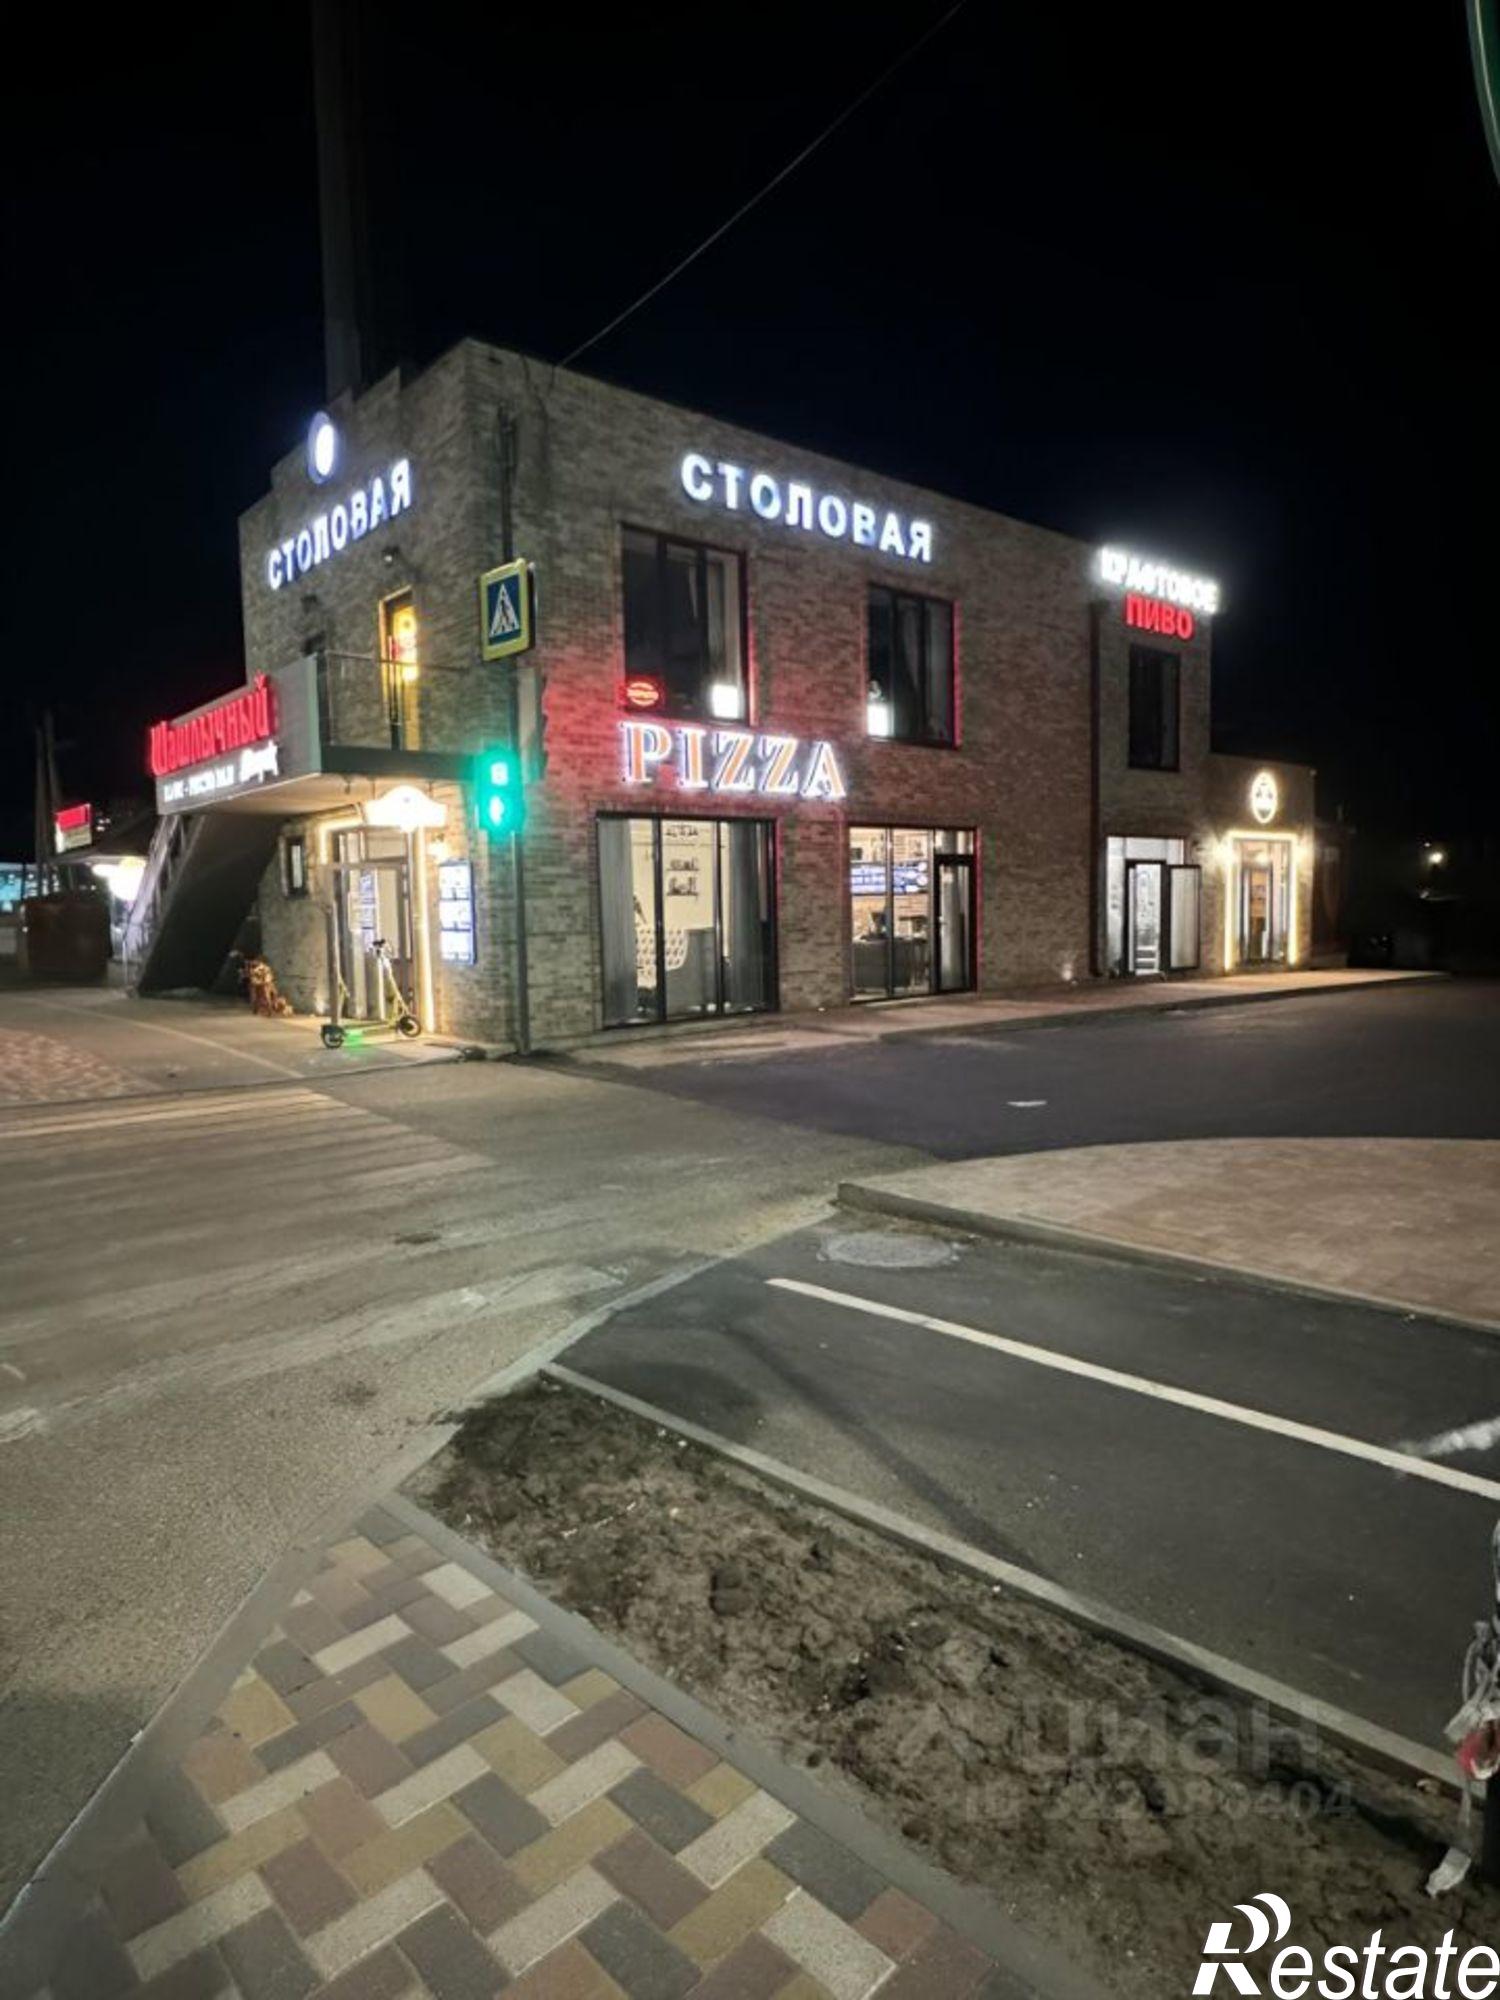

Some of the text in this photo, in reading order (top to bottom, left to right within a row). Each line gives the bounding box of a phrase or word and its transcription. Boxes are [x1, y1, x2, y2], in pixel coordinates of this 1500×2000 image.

[267, 458, 413, 590] СТОЛОВАЯ
[680, 453, 934, 564] СТОЛОВАЯ
[1126, 592, 1193, 639] ПИВО
[619, 720, 849, 802] PIZZA
